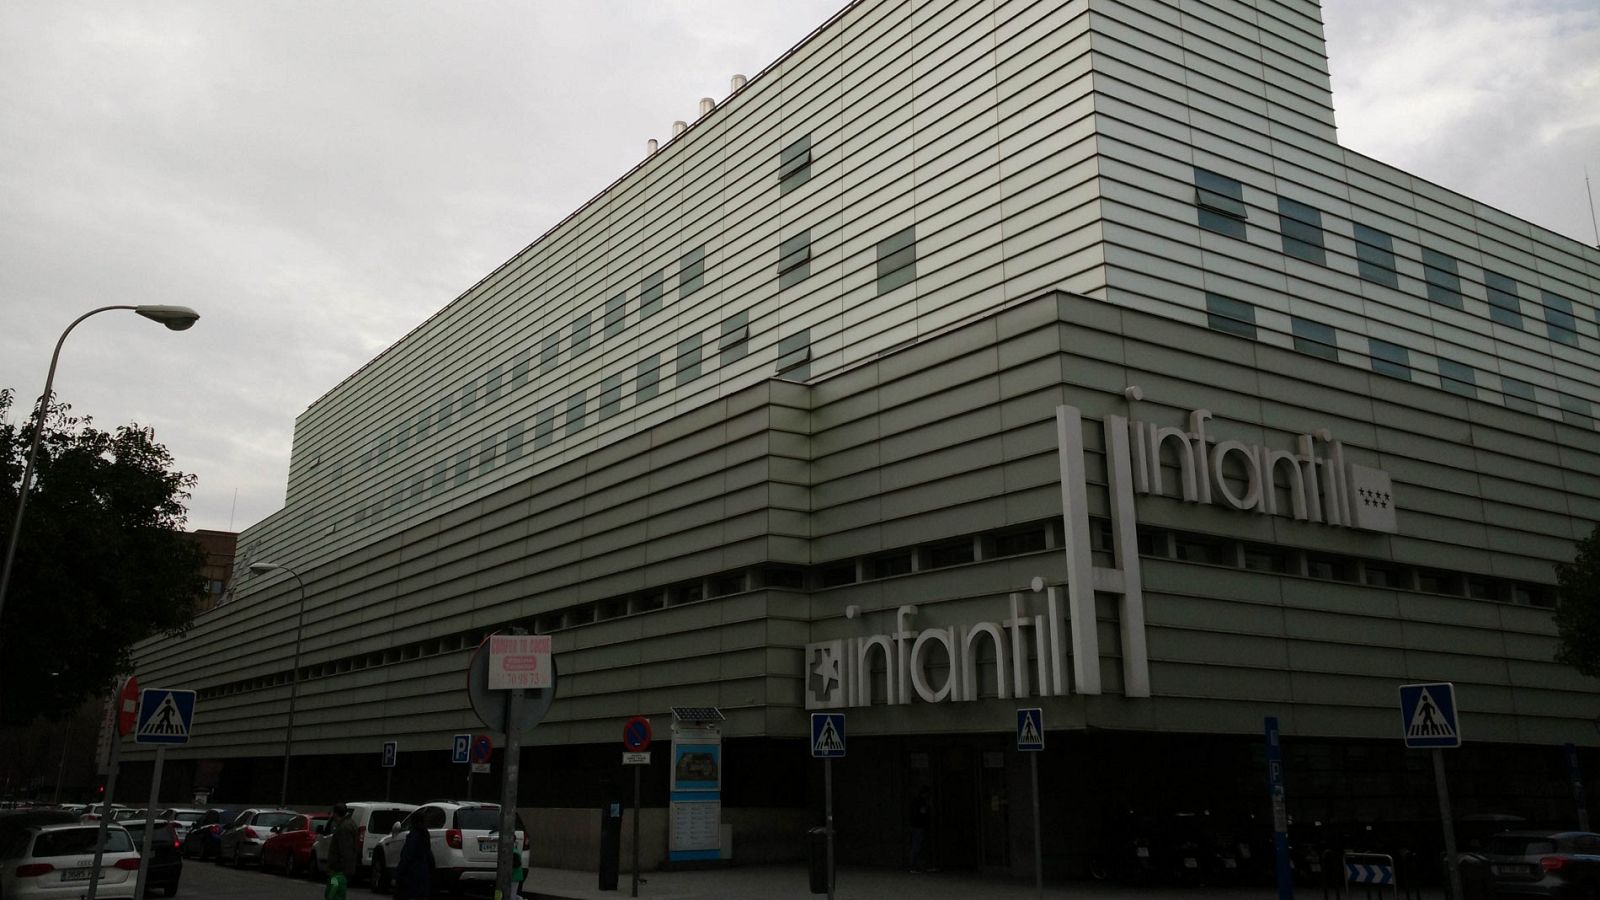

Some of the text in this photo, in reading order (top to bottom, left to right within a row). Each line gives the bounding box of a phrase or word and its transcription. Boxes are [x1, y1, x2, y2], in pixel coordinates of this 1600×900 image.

[1126, 386, 1352, 527] infantil
[846, 576, 1069, 707] infantil
[385, 744, 394, 765] P
[456, 738, 467, 760] P
